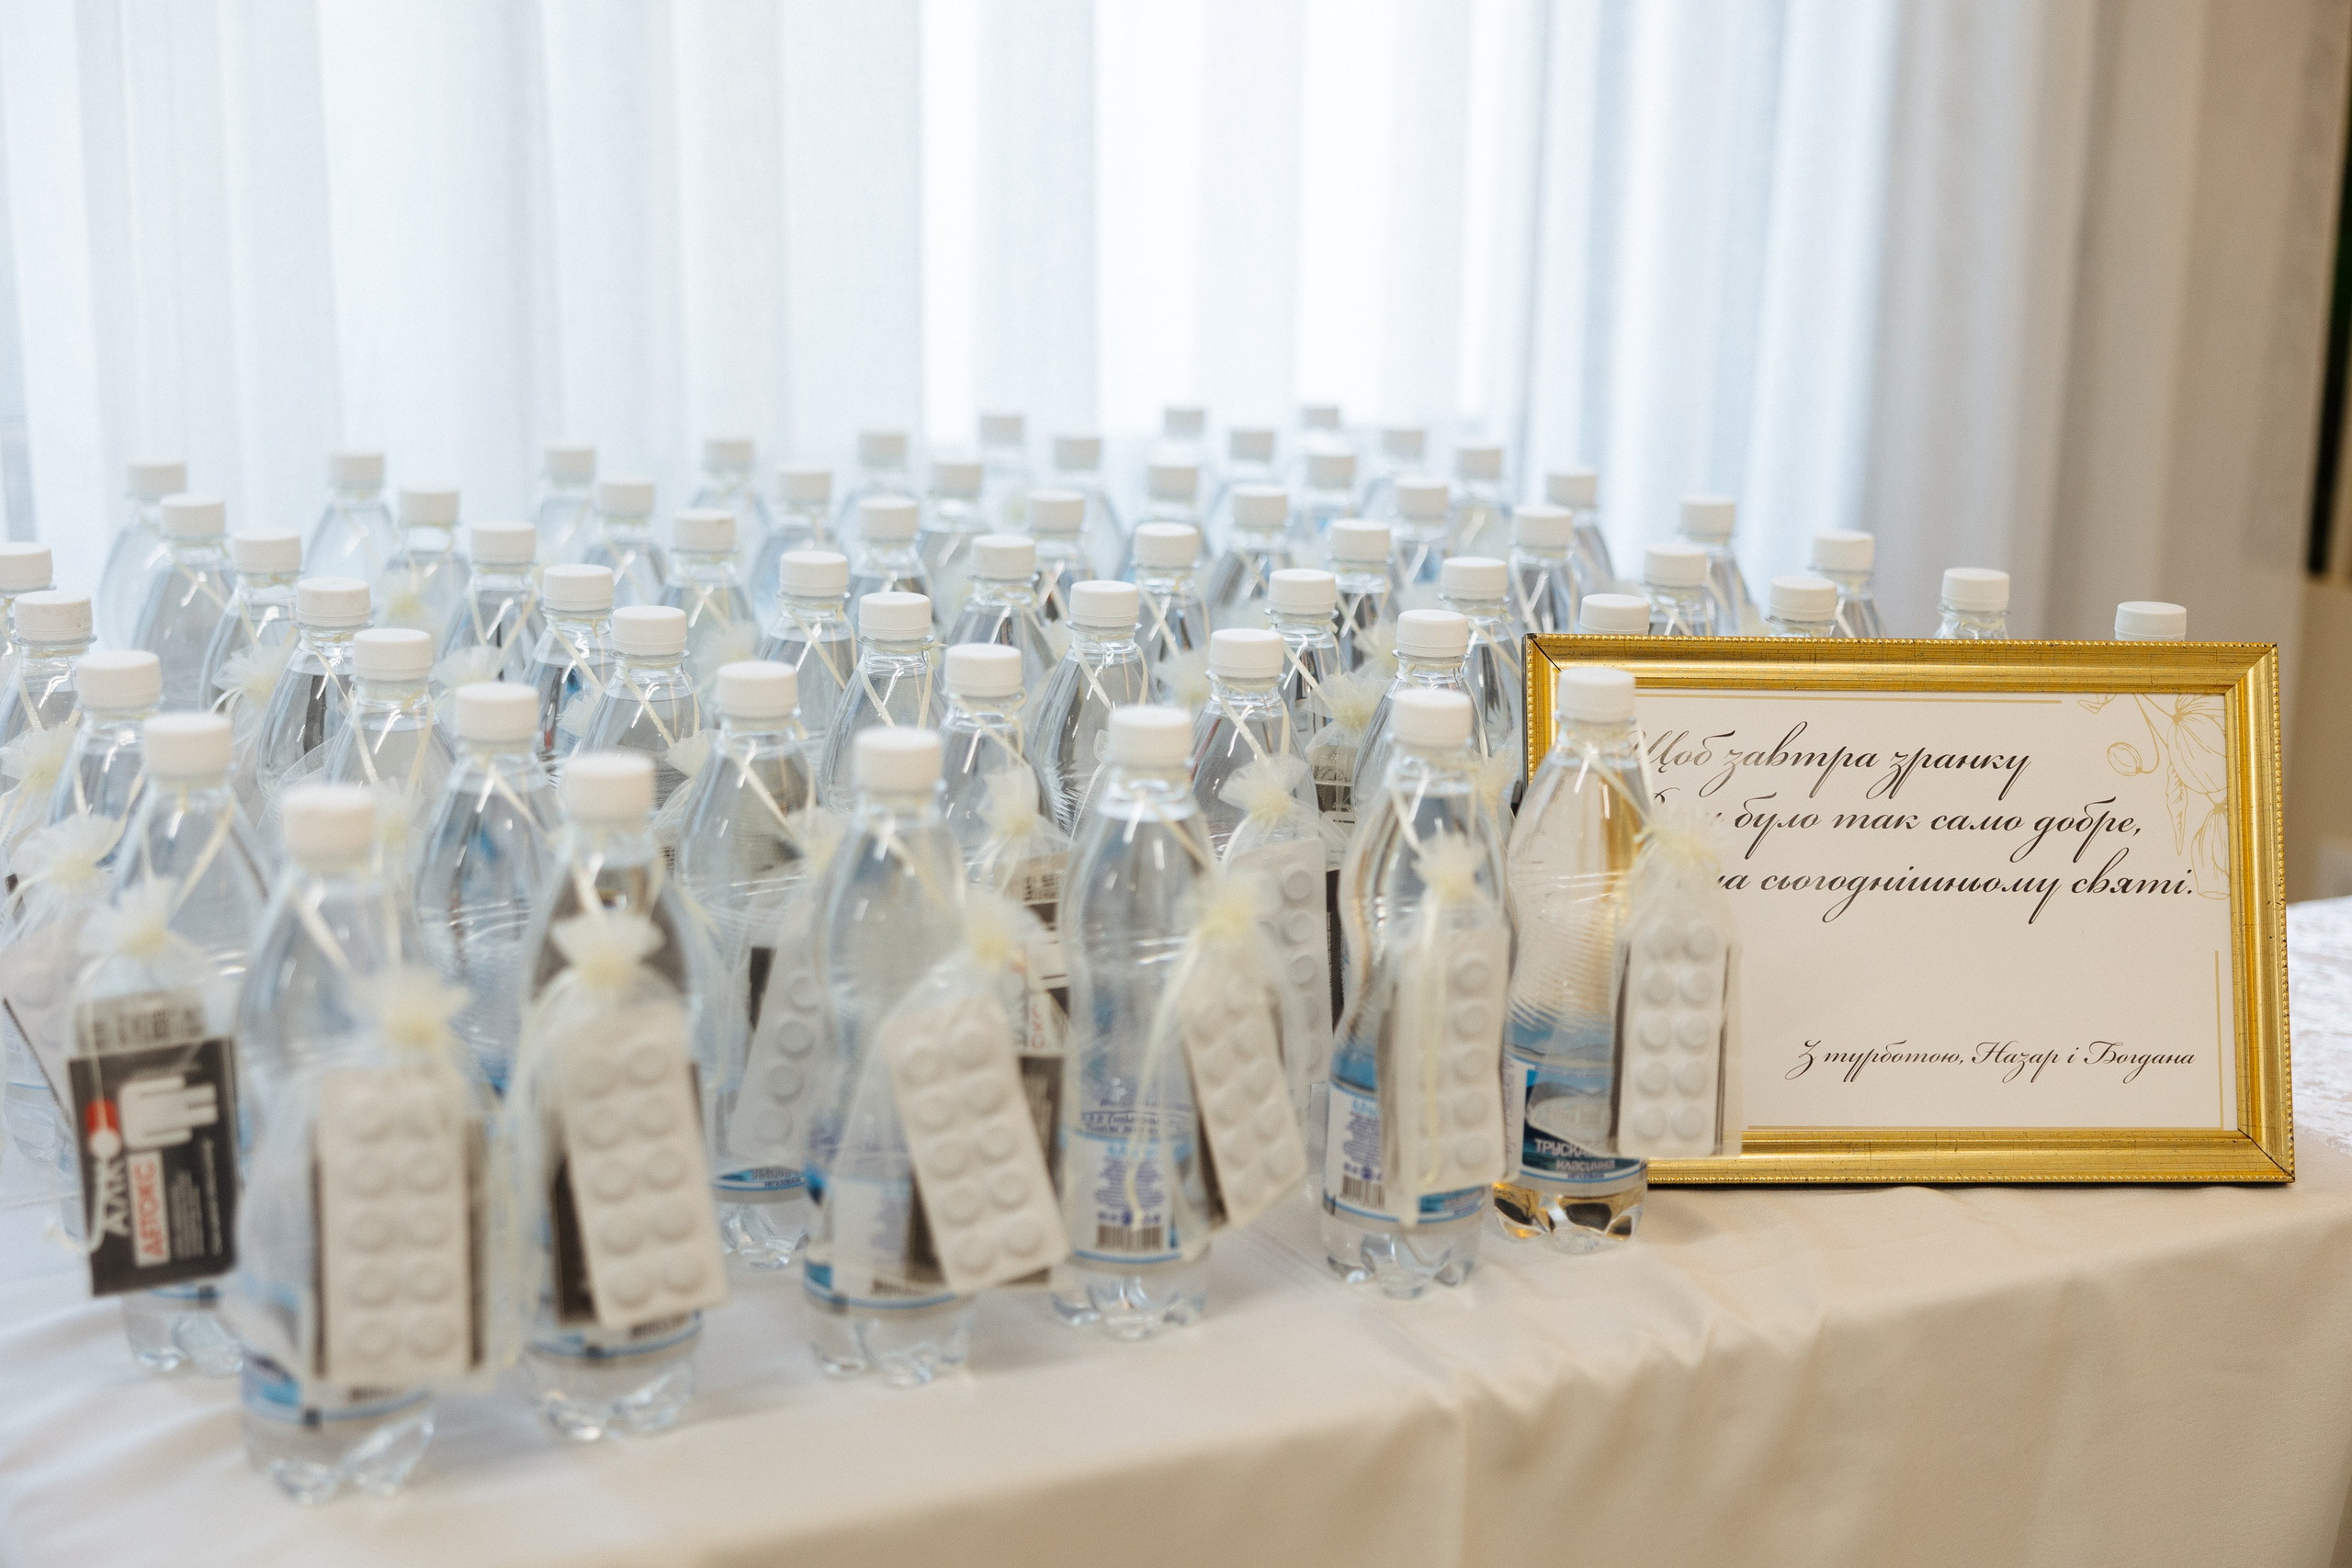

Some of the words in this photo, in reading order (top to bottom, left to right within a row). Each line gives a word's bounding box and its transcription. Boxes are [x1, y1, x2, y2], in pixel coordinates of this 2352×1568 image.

[1698, 720, 1881, 799] завтра
[1865, 747, 2032, 802] зранку
[1733, 791, 1824, 861] було
[1831, 812, 1921, 830] так
[1929, 814, 2026, 832] само
[2008, 795, 2142, 864] добре,
[1759, 865, 2063, 925] сьогоднішньому
[2070, 846, 2194, 896] святі.
[1784, 1039, 1822, 1081] З
[1823, 1039, 1964, 1084] турботою,
[1971, 1040, 2062, 1084] Назар
[2066, 1046, 2076, 1064] і
[2083, 1040, 2196, 1085] Богдана
